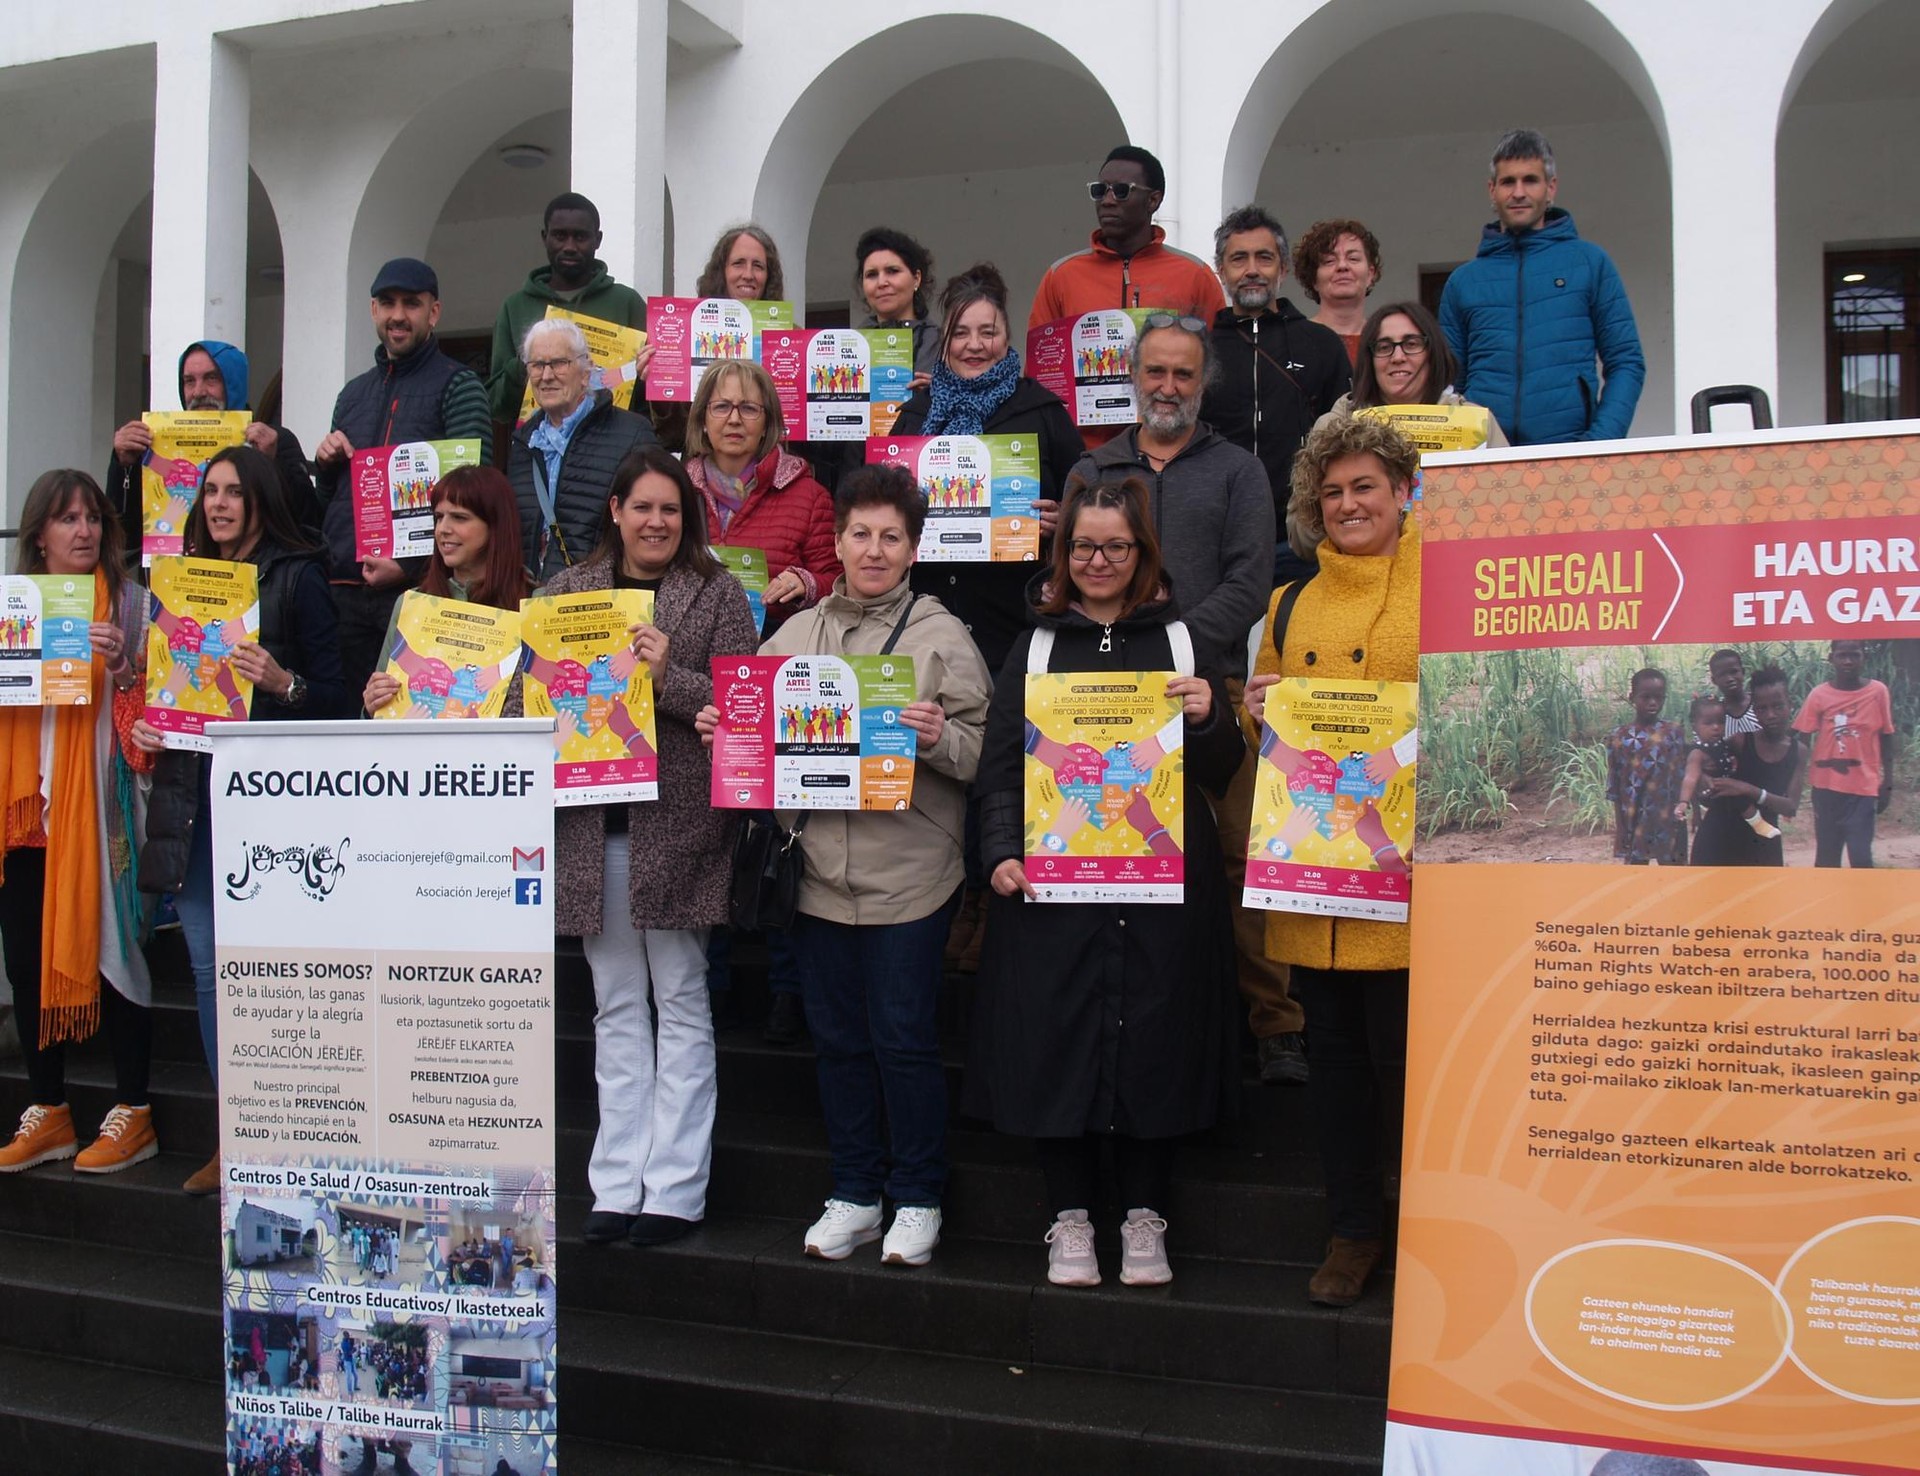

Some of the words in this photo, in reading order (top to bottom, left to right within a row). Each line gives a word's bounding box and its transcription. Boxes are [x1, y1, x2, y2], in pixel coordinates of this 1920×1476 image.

[1755, 538, 1919, 577] HAURR
[1475, 550, 1642, 600] SENEGALI
[1734, 590, 1814, 626] ETA
[1826, 587, 1920, 623] GAZ
[1474, 602, 1590, 636] BEGIRADA
[1599, 600, 1642, 630] BAT
[226, 763, 408, 796] ASOCIACIÓN
[419, 764, 534, 796] JËRËJËF
[357, 851, 511, 865] asociacionjerejef@gmail.com
[416, 886, 472, 897] Asociación
[476, 887, 511, 900] Jerejef
[1536, 922, 1619, 937] Senegalen
[1625, 924, 1690, 938] biztanle
[1695, 926, 1772, 941] gehienak
[1777, 929, 1844, 942] gazteak
[1850, 929, 1887, 944] dira,
[1535, 940, 1581, 952] %60a.
[1594, 942, 1659, 955] Haurren
[1672, 944, 1730, 957] babesa
[1743, 947, 1808, 960] erronka
[1823, 948, 1882, 962] handia
[220, 961, 298, 980] ¿QUIENES
[305, 963, 372, 980] SOMOS?
[389, 966, 474, 982] NORTZUK
[480, 968, 542, 983] GARA?
[1535, 958, 1592, 972] Human
[1600, 960, 1652, 976] Rights
[1660, 963, 1740, 976] Watch-en
[1748, 966, 1816, 981] arabera,
[1823, 968, 1890, 982] 100.000
[228, 984, 243, 997] De
[262, 985, 304, 1000] ilusión,
[310, 986, 326, 999] las
[330, 991, 364, 1003] ganas
[1534, 976, 1578, 990] baino
[1583, 979, 1650, 995] gehiago
[1655, 982, 1712, 995] eskean
[1718, 982, 1785, 997] ibiltzera
[1791, 985, 1879, 1001] behartzen
[381, 994, 424, 1006] Ilusiorik,
[428, 994, 485, 1009] laguntzeko
[489, 997, 550, 1010] gogoetatik
[233, 1004, 247, 1017] de
[251, 1006, 293, 1020] ayudar
[323, 1007, 363, 1023] alegría
[397, 1017, 413, 1026] eta
[417, 1018, 482, 1029] poztasunetik
[487, 1020, 514, 1030] sortu
[519, 1019, 532, 1030] da
[1533, 1014, 1615, 1029] Herrialdea
[1622, 1017, 1707, 1033] hezkuntza
[1714, 1021, 1748, 1034] krisi
[1754, 1024, 1849, 1039] estruktural
[1856, 1027, 1890, 1041] larri
[272, 1029, 306, 1042] surge
[418, 1037, 456, 1050] JËRËJËF
[460, 1040, 514, 1051] ELKARTEA
[1532, 1032, 1588, 1046] gilduta
[1597, 1035, 1642, 1051] dago:
[1651, 1038, 1699, 1053] gaizki
[1708, 1041, 1822, 1057] ordaindutako
[233, 1044, 312, 1058] ASOCIACIÓN
[1531, 1053, 1598, 1068] gutxiegi
[1605, 1055, 1635, 1067] edo
[1642, 1057, 1690, 1071] gaizki
[1698, 1059, 1784, 1077] hornituak,
[1792, 1063, 1863, 1079] ikasleen
[254, 1080, 293, 1092] Nuestro
[297, 1082, 340, 1095] principal
[411, 1071, 490, 1084] PREBENTZIOA
[494, 1077, 518, 1087] gure
[1530, 1071, 1555, 1082] eta
[1561, 1072, 1658, 1088] goi-mailako
[1664, 1076, 1722, 1091] zikloak
[1728, 1080, 1890, 1100] lan-merkatuarekin
[228, 1095, 266, 1108] objetivo
[296, 1098, 367, 1112] PREVENCIÓN,
[413, 1092, 452, 1104] helburu
[456, 1095, 496, 1108] nagusia
[500, 1096, 516, 1108] da,
[1530, 1089, 1566, 1102] tuta.
[239, 1111, 284, 1124] haciendo
[287, 1114, 329, 1128] hincapié
[389, 1113, 445, 1125] OSASUNA
[449, 1118, 464, 1126] eta
[468, 1117, 542, 1128] HEZKUNTZA
[235, 1127, 269, 1138] SALUD
[294, 1130, 361, 1144] EDUCACIÓN.
[429, 1137, 499, 1150] azpimarratuz.
[1529, 1126, 1614, 1145] Senegalgo
[1622, 1134, 1688, 1147] gazteen
[1695, 1136, 1775, 1153] elkarteak
[1783, 1144, 1875, 1159] antolatzen
[1883, 1148, 1906, 1161] ari
[1528, 1144, 1620, 1162] herrialdean
[1626, 1153, 1743, 1170] etorkizunaren
[1748, 1159, 1785, 1173] alde
[1791, 1161, 1912, 1182] borrokatzeko.
[230, 1168, 282, 1184] Centros
[287, 1172, 306, 1186] De
[311, 1173, 349, 1188] Salud
[366, 1176, 489, 1197] Osasun-zentroak
[308, 1287, 361, 1305] Centros
[366, 1292, 451, 1313] Educativos/
[456, 1298, 545, 1317] Ikastetxeak
[1583, 1297, 1629, 1309] Gazteen
[1632, 1302, 1681, 1314] ehuneko
[1684, 1306, 1734, 1319] handiari
[1616, 1313, 1676, 1328] Senegalgo
[1678, 1319, 1734, 1332] gizarteak
[1579, 1322, 1632, 1336] lan-indar
[1633, 1327, 1674, 1339] handia
[1676, 1333, 1695, 1342] eta
[1698, 1334, 1735, 1345] hazte-
[1590, 1336, 1604, 1345] ko
[1607, 1338, 1657, 1351] ahalmen
[1660, 1342, 1701, 1355] handia
[236, 1396, 276, 1414] Niños
[281, 1401, 323, 1418] Talibe
[338, 1407, 379, 1424] Talibe
[385, 1412, 442, 1431] Haurrak
